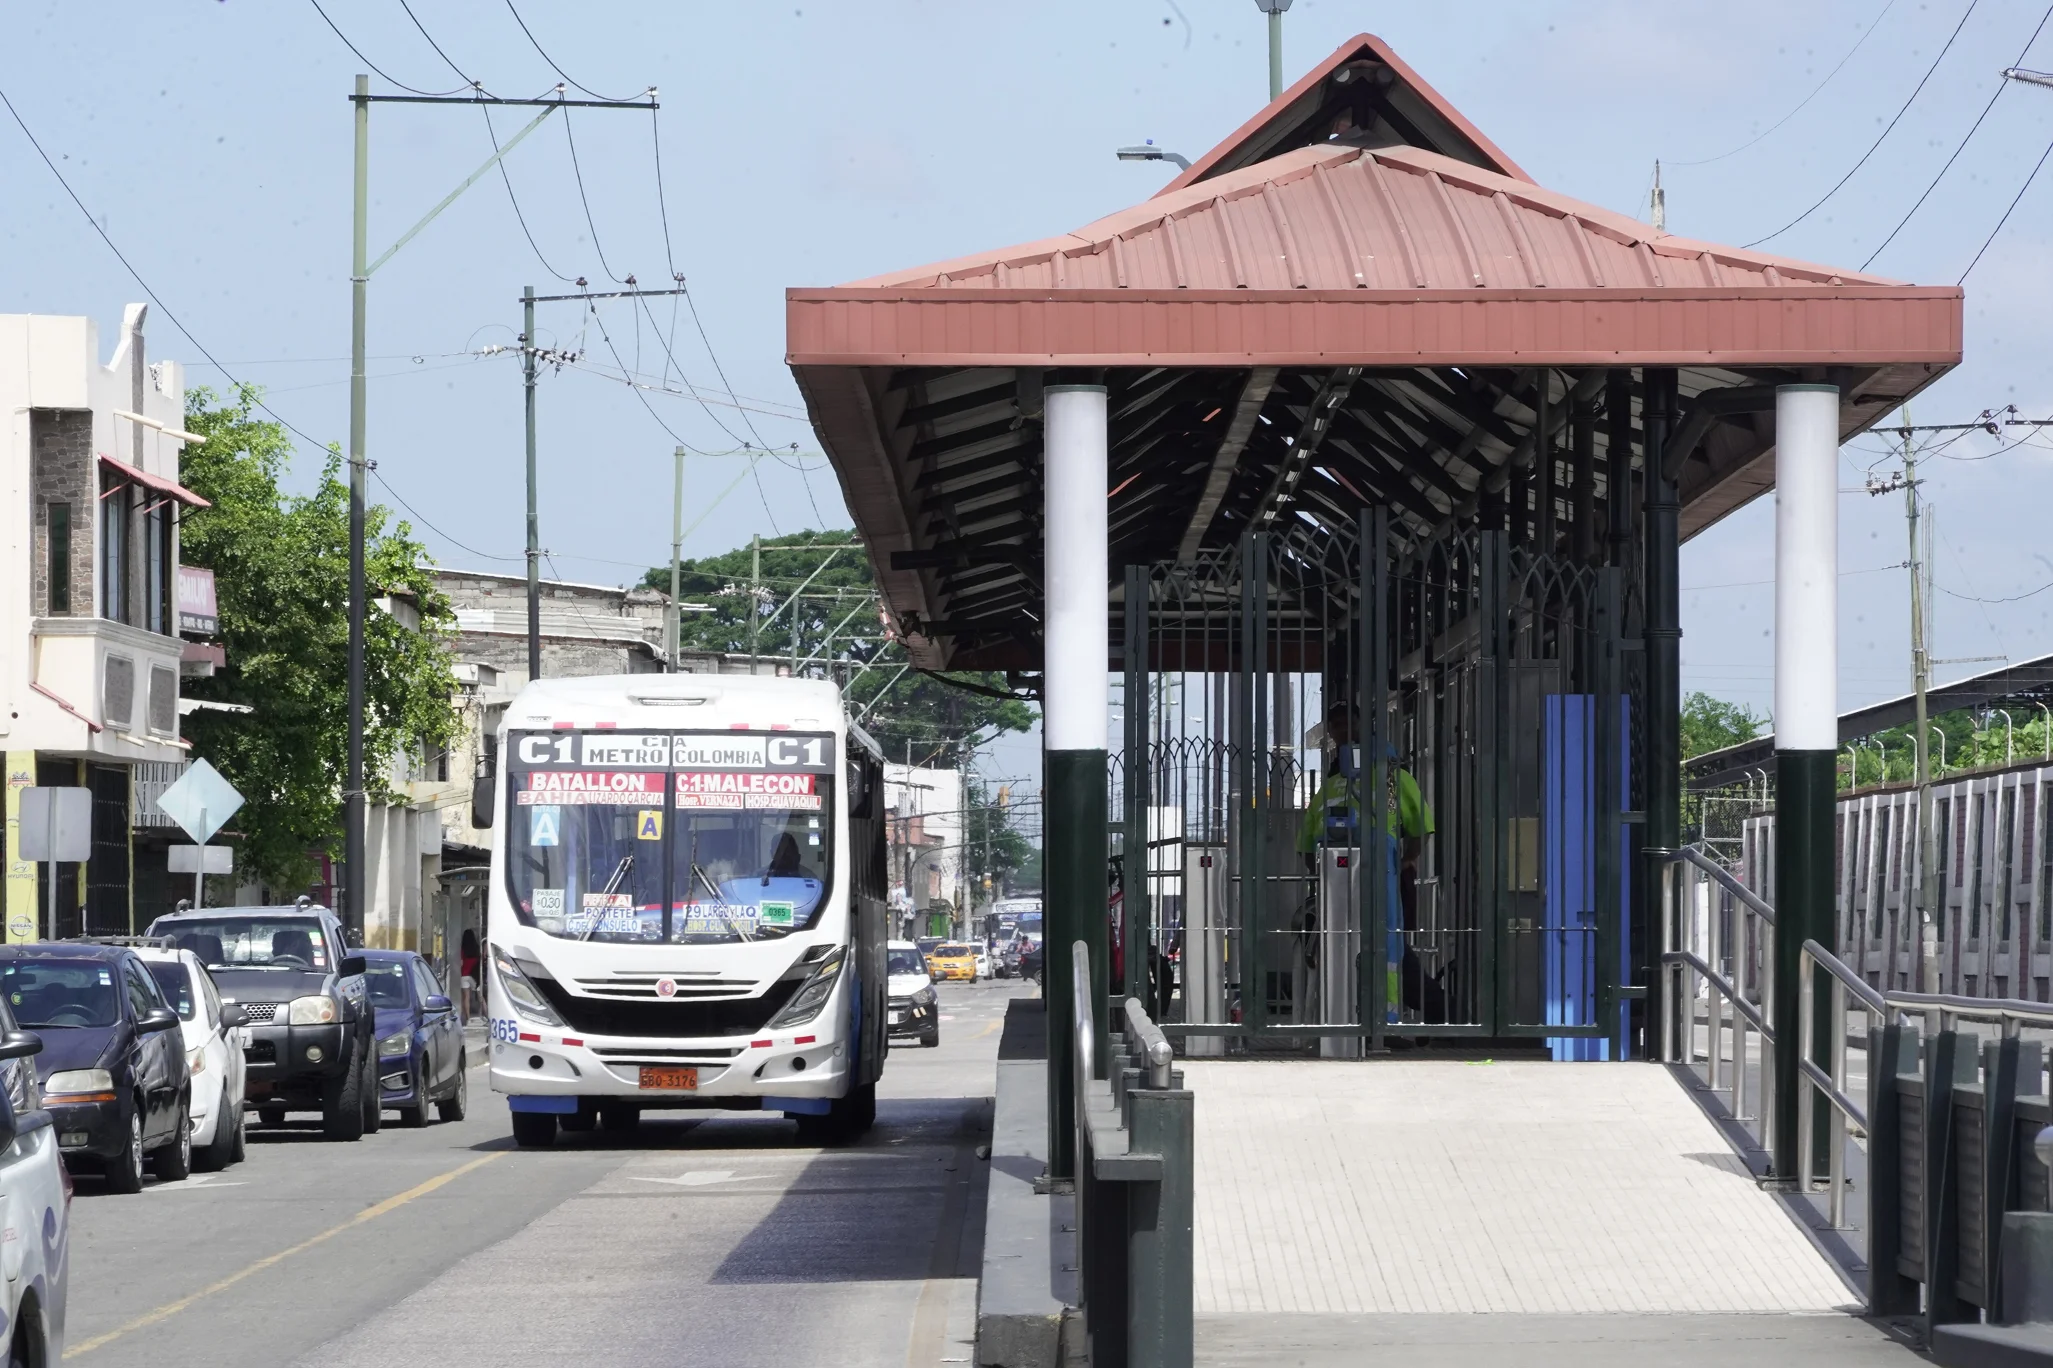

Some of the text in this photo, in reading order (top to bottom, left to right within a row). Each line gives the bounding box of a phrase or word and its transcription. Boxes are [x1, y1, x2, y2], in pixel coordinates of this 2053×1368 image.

[519, 736, 575, 763] C1
[642, 736, 687, 748] CIA
[589, 749, 762, 765] METRO COLOMBIA
[768, 738, 826, 766] C1
[531, 772, 645, 791] BATALLON
[519, 792, 589, 804] BAHIA
[627, 793, 662, 805] GARCIA
[531, 813, 559, 846] A
[641, 817, 658, 836] A
[686, 905, 701, 918] 29
[768, 907, 786, 917] 0365
